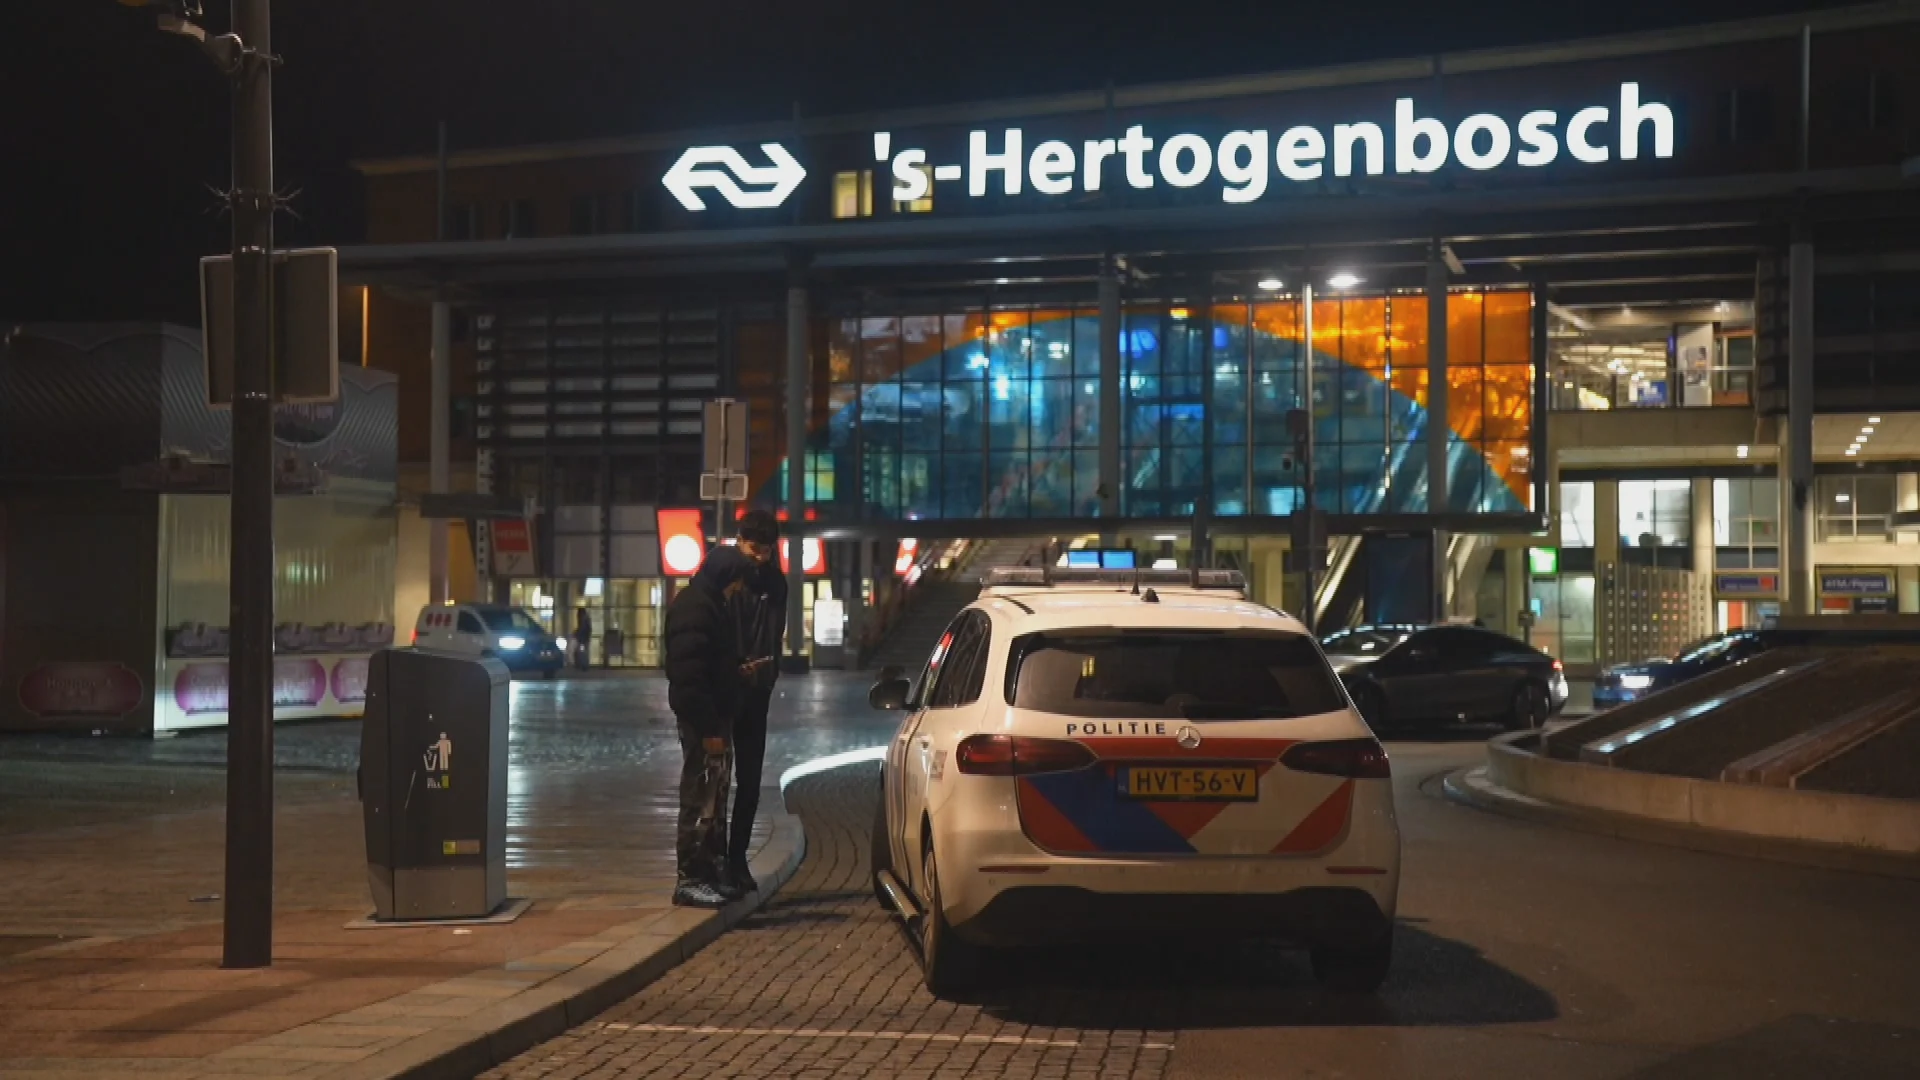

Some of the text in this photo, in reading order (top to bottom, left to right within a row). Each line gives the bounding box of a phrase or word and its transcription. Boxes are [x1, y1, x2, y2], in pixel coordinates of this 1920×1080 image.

[873, 82, 1675, 205] 's-Hertogenbosch
[1066, 722, 1167, 736] POLITIE
[1136, 769, 1247, 793] HVT-56-V
